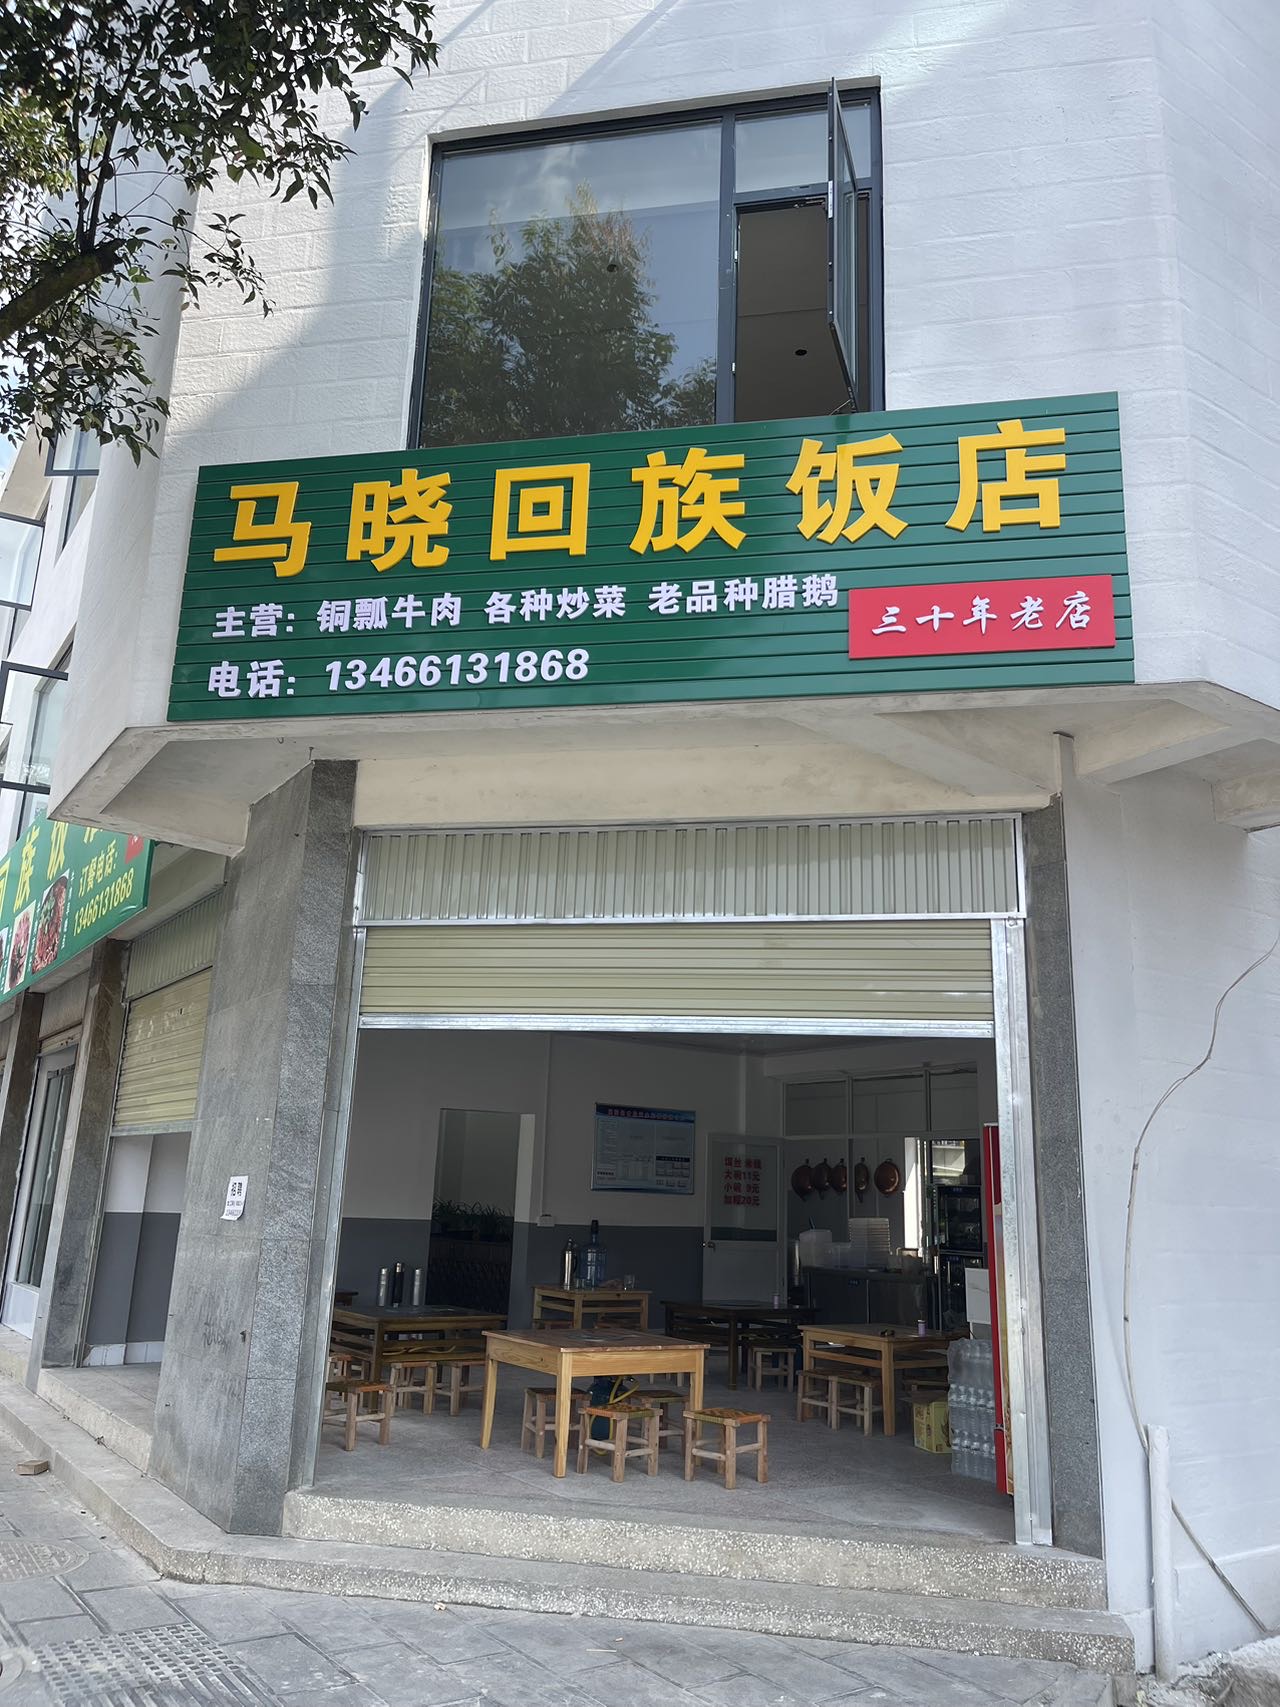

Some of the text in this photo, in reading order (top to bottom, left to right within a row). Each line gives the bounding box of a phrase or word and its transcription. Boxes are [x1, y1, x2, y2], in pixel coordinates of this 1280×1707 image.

[213, 419, 1066, 577] 马晓回族饭店
[317, 592, 461, 633] 铜瓢牛肉
[485, 585, 627, 624] 各种炒菜
[648, 573, 838, 615] 老品种腊鹅
[871, 590, 1092, 636] 三十年老店
[325, 648, 589, 692] 13466131868
[73, 867, 134, 936] 13466131868
